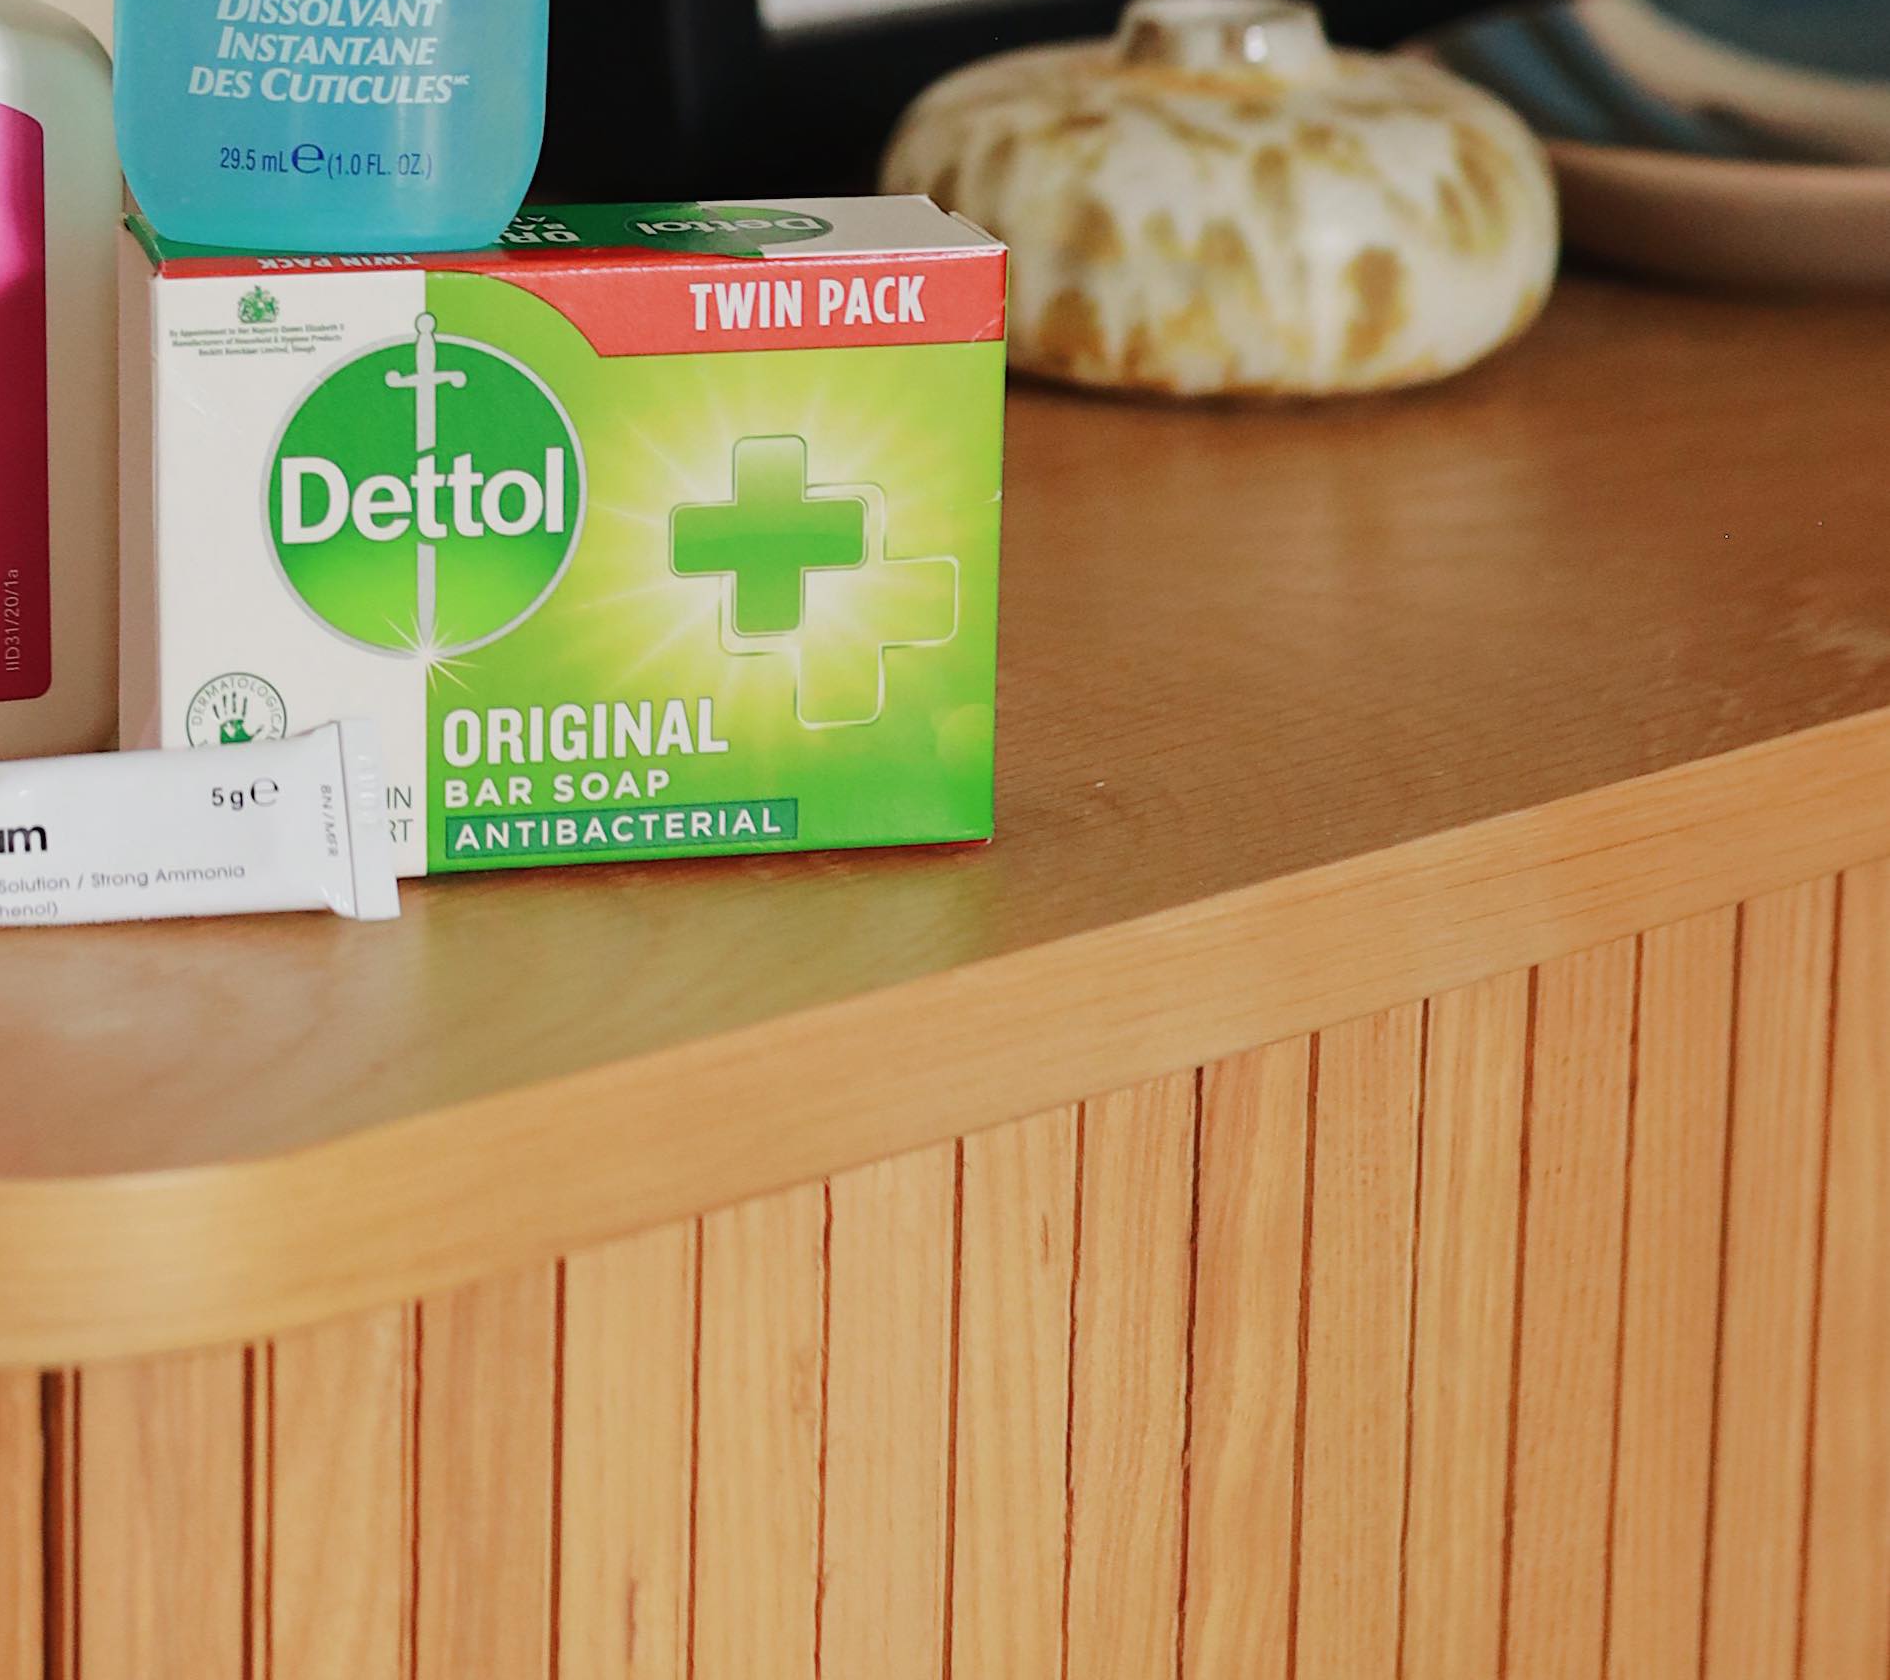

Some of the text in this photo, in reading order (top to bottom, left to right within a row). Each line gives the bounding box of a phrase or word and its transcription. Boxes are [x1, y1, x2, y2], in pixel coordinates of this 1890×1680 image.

[187, 66, 253, 99] DES
[220, 146, 257, 171] 29.5
[262, 151, 289, 173] mL
[327, 152, 361, 180] (1.0
[367, 153, 391, 176] FL.
[398, 153, 433, 180] OZ.)
[635, 216, 824, 235] Dettol
[688, 275, 926, 331] TWIN PACK
[280, 446, 566, 545] Dettol
[443, 697, 730, 768] ORIGINAL
[212, 788, 224, 807] 5
[444, 769, 671, 809] BAR SOAP
[454, 807, 782, 851] ANTIBACTERIAL
[90, 871, 149, 889] Strong
[155, 863, 246, 884] Ammonia
